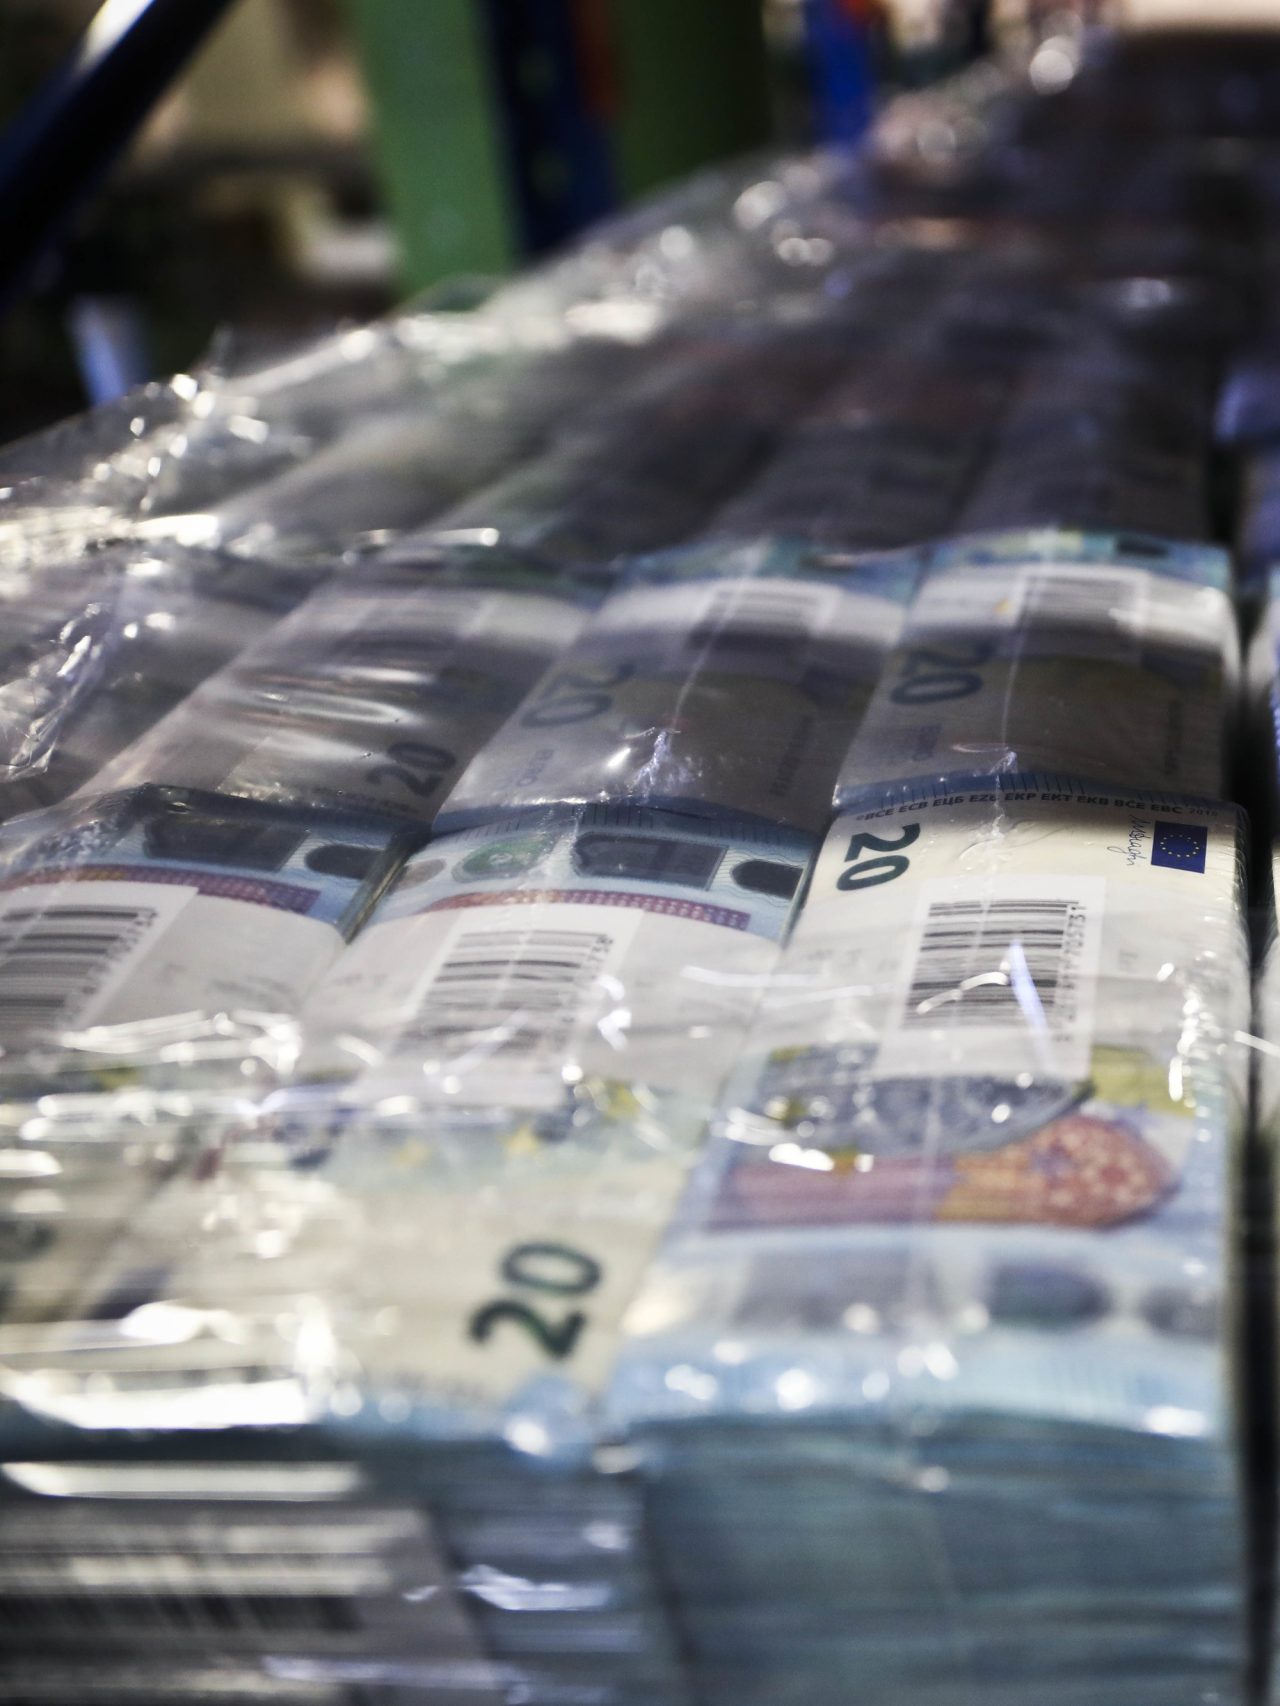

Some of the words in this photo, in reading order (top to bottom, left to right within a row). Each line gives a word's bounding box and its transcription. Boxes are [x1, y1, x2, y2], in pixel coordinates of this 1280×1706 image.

[366, 739, 457, 797] 20
[897, 801, 929, 813] ECB
[1004, 792, 1037, 801] EKP
[1041, 793, 1073, 802] EKT
[1150, 803, 1184, 814] EBC
[837, 822, 921, 891] 20
[466, 1242, 605, 1362] 20
